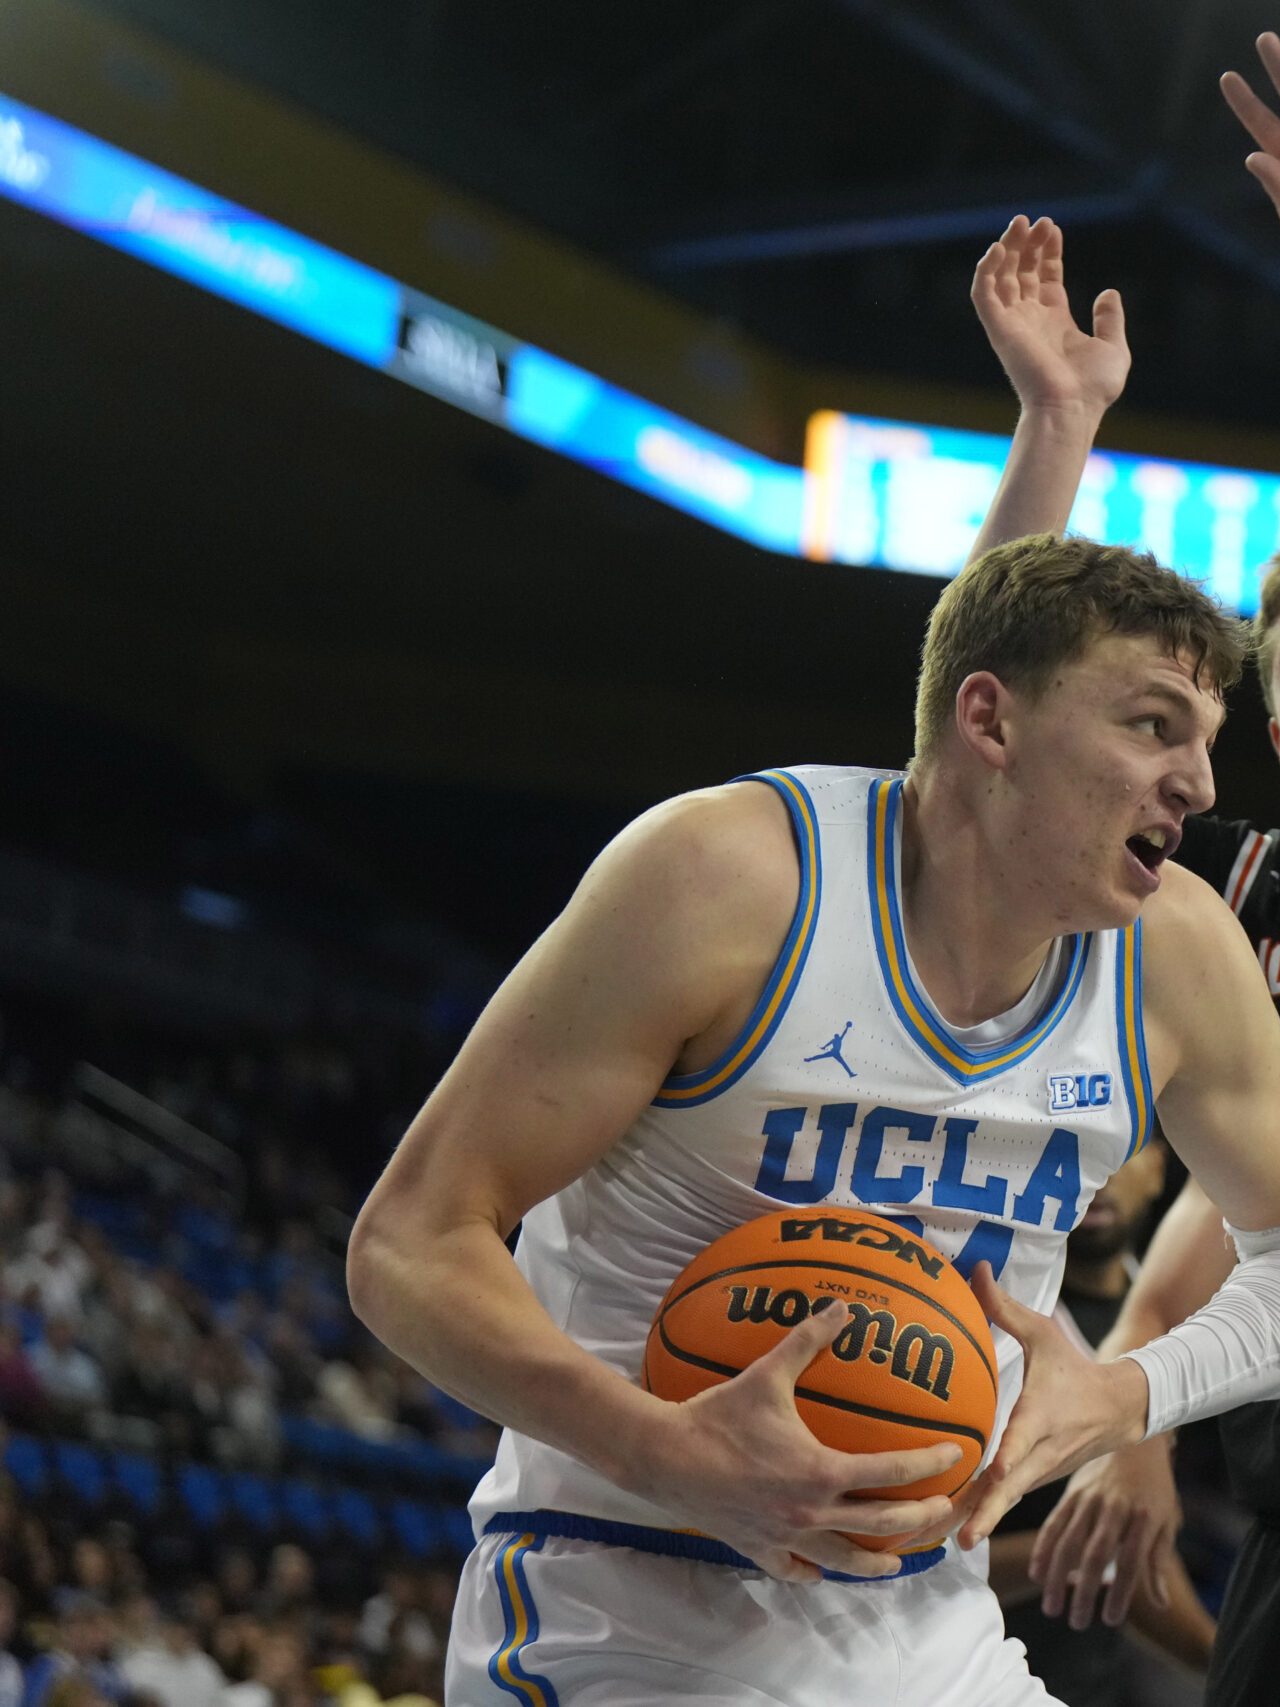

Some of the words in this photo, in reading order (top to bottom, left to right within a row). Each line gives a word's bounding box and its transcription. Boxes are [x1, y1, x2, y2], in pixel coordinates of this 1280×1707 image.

[753, 1103, 1081, 1232] UCLA
[781, 1218, 944, 1280] NCAA
[814, 1280, 851, 1296] NXT
